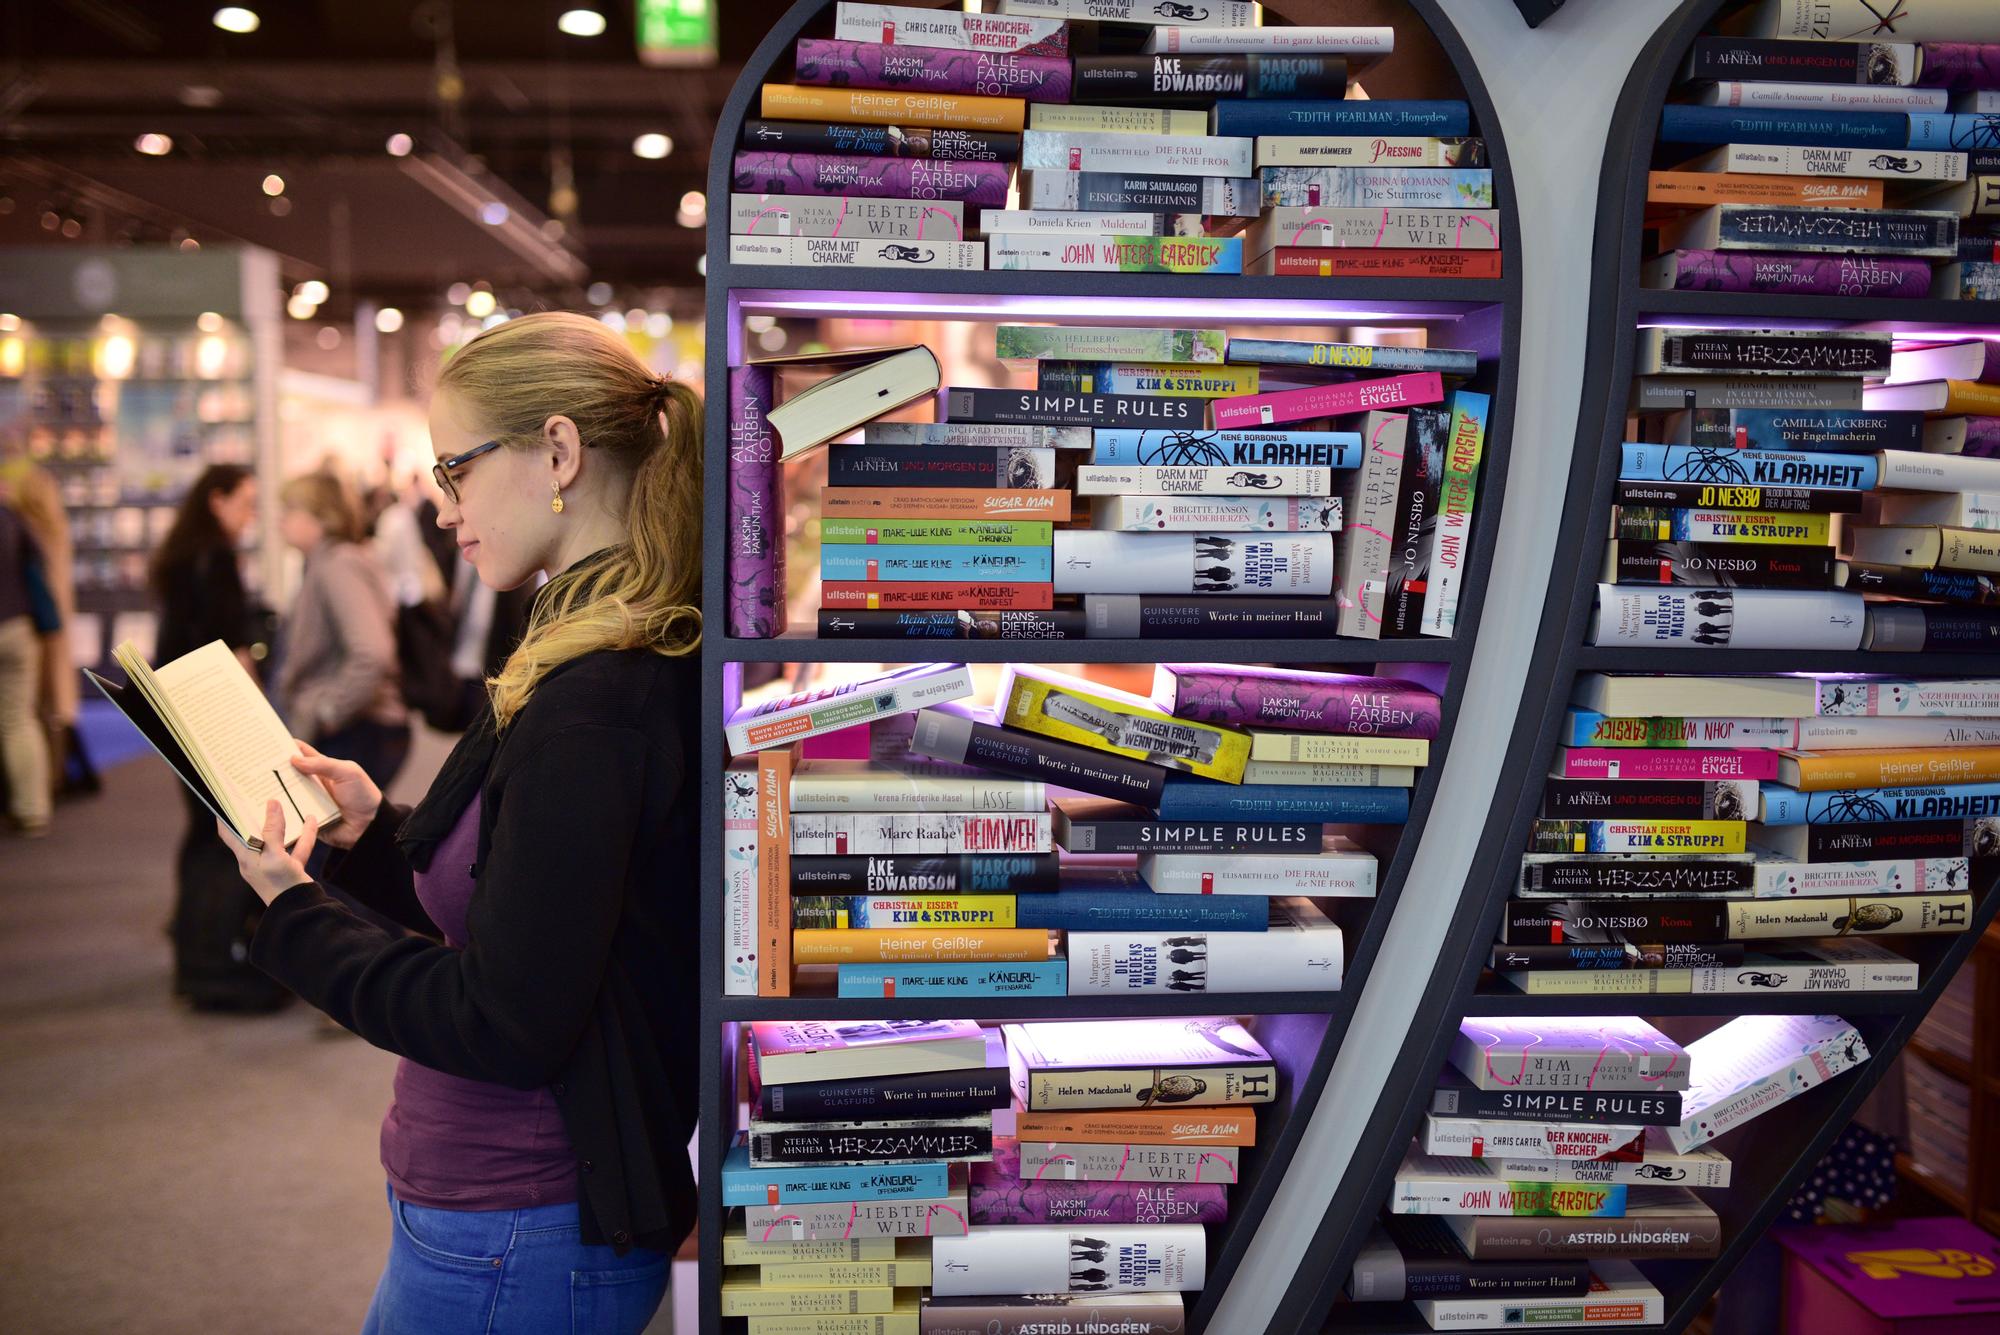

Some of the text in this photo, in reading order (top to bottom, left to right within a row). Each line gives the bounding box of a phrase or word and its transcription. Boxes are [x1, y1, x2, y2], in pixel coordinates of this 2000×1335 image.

[905, 22, 957, 35] CHRIS CARTER
[964, 18, 1033, 35] DER KNOCHEN-
[973, 33, 1017, 48] BRECHER
[1190, 35, 1265, 45] Camille Anseaume
[1273, 35, 1380, 47] Ein ganz kleines Glück
[885, 57, 923, 67] LAKSMI
[977, 54, 1019, 67] ALLE
[1154, 56, 1181, 75] ÅKE
[885, 66, 948, 80] PAMUNTJAK
[977, 66, 1043, 84] FARBEN
[976, 82, 1011, 96] ROT
[1154, 73, 1243, 93] EDWARDSON
[1260, 74, 1296, 92] PARK
[851, 93, 957, 110] Heiner Geißler
[1288, 111, 1448, 124] EDITH PEARLMAN Honeydew
[826, 126, 885, 139] Meine Sicht
[933, 131, 971, 140] HANS-
[835, 138, 886, 152] der Dinge
[932, 139, 986, 150] DIETRICH
[1156, 145, 1202, 155] DIE FRAU
[1300, 146, 1352, 155] HARRY KÄMMERER
[932, 149, 996, 160] GENSCHER
[1370, 140, 1421, 163] PRESSING
[1802, 149, 1851, 161] DARM MIT
[1167, 157, 1229, 167] die NIE FROR
[1807, 161, 1847, 173] CHARME
[1124, 181, 1197, 193] KARIN SALVALAGGIO
[1355, 176, 1450, 187] CORINA BOMANN
[1089, 193, 1197, 207] EISIGES GEHEIMNIS
[1363, 188, 1442, 200] Die Sturmrose
[1736, 215, 1880, 237] HERZSAMMLER
[1887, 223, 1929, 231] AHNHEM
[1890, 232, 1924, 240] STEFAN
[1061, 243, 1220, 266] JOHN WATERS CARSICK
[1360, 383, 1403, 395] ASPHALT
[1304, 391, 1354, 403] JOHANNA
[1360, 391, 1406, 406] ENGEL
[1020, 396, 1190, 418] SIMPLE RULES
[1290, 397, 1354, 412] HOLMSTRÖM
[1221, 405, 1259, 418] ullstein
[746, 396, 758, 463] FARBEN
[1773, 417, 1887, 430] CAMILLA LÄCKBERG
[731, 422, 744, 463] ALLE
[1783, 431, 1876, 441] Die Engelmacherin
[759, 430, 771, 463] ROT
[1234, 443, 1348, 465] KLARHEIT
[1698, 487, 1760, 508] JO NESBØ
[1766, 489, 1810, 498] BLOOD ON SNOW
[984, 495, 1054, 509] SUGAR MAN
[1765, 498, 1810, 510] DER AUFTRAG
[752, 491, 761, 554] PAMUNTJAK
[743, 516, 751, 554] LAKSMI
[1245, 544, 1258, 585] MACHER
[1259, 542, 1272, 587] FRIEDENS
[1274, 557, 1287, 573] DIE
[1290, 543, 1298, 587] MacMillan
[1303, 545, 1312, 584] Margaret
[826, 591, 866, 600] ullstein
[884, 592, 953, 601] MARC-UWE KLING
[969, 585, 1019, 598] KÄNGURU-
[979, 597, 1012, 606] MANIFEST
[1143, 607, 1200, 616] GUINEVERE
[1209, 610, 1322, 622] Worte in meiner Hand
[1148, 616, 1200, 625] GLASFURD
[1081, 713, 1119, 733] CARVER
[1132, 720, 1170, 737] MORGEN
[1125, 733, 1151, 749] WENN
[1153, 739, 1167, 751] DU
[1944, 729, 1970, 742] Alle
[873, 793, 963, 803] Verena Friederike Hasel
[972, 786, 1016, 810] LASSE
[1883, 788, 1945, 798] RENÉ BORBONUS
[796, 830, 833, 839] ullstein
[880, 827, 956, 839] Marc Raabe
[963, 819, 1036, 851] HEIMWEH
[1610, 826, 1691, 834] CHRISTIAN EISERT
[1628, 835, 1724, 846] KIM & STRUPPI
[1804, 870, 1877, 880] BRIGITTE JANSON
[1801, 878, 1879, 888] HOLUNDERHERZEN
[1572, 916, 1648, 928] JO NESBØ
[1661, 917, 1693, 927] Koma
[1058, 1084, 1131, 1095] Helen Macdonald
[1226, 1073, 1234, 1101] Habicht
[1243, 1075, 1268, 1098] H
[784, 1137, 819, 1145] STEFAN
[829, 1135, 977, 1154] HERZSAMMLER
[782, 1145, 823, 1154] AHNHEM
[1568, 1232, 1689, 1244] ASTRID LINDGREN
[1440, 1311, 1474, 1321] ullstein
